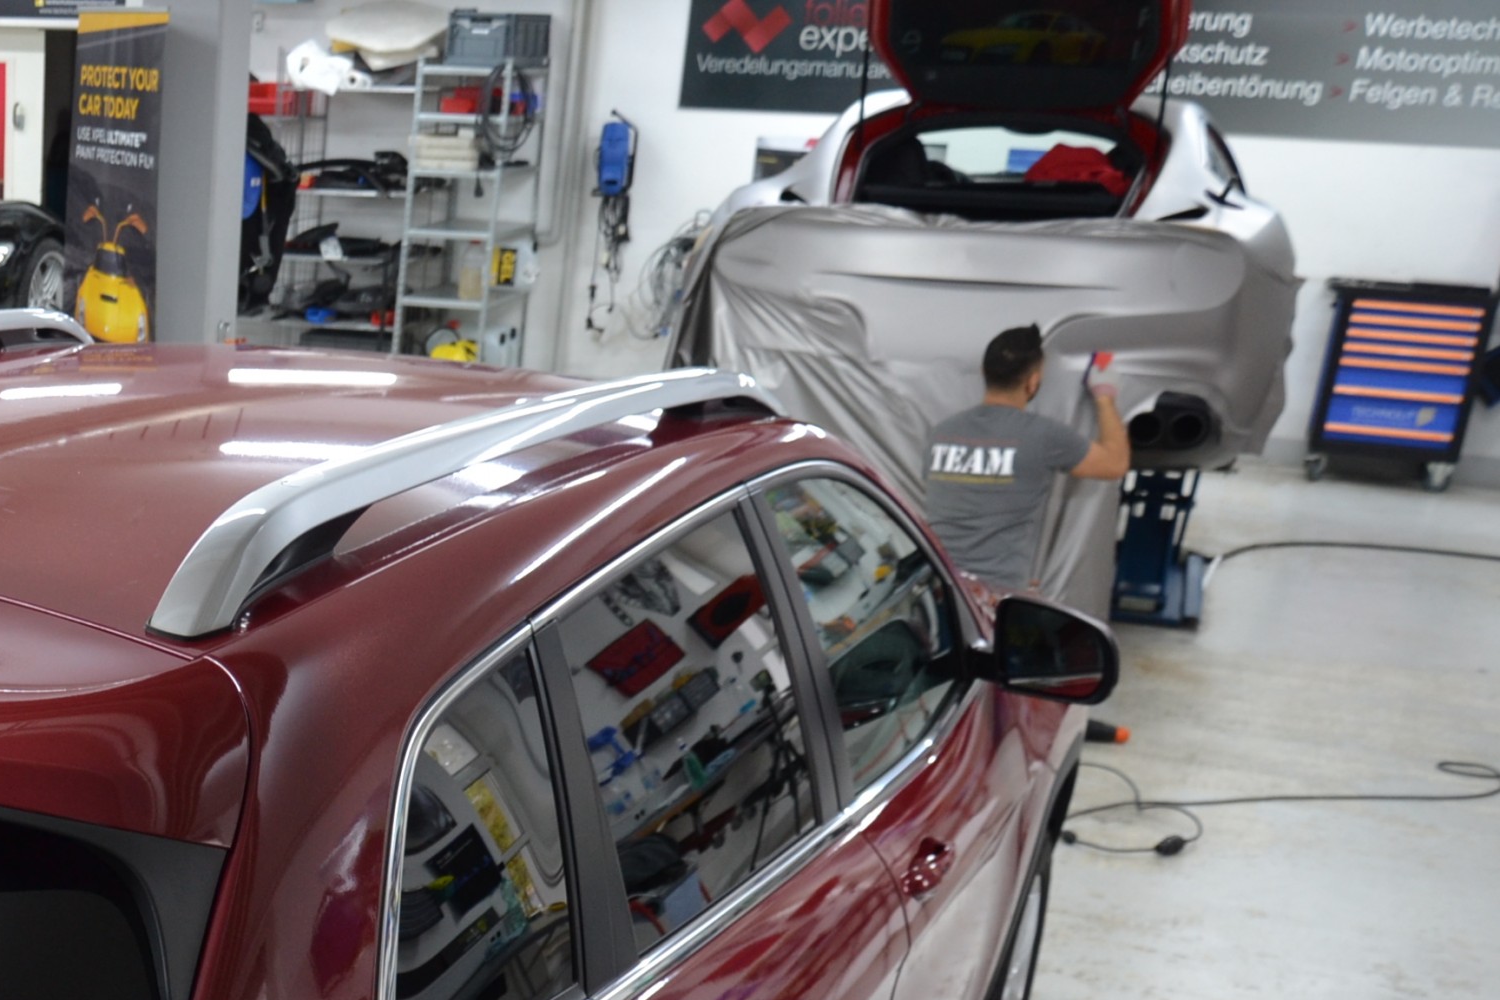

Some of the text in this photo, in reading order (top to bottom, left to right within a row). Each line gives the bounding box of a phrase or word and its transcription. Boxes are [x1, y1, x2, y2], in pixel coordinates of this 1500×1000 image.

[80, 64, 160, 92] PROTECT YOUR
[78, 93, 140, 121] CAR TODAY
[1349, 78, 1438, 111] Felgen
[1442, 82, 1464, 109] &
[929, 443, 1018, 476] TEAM
